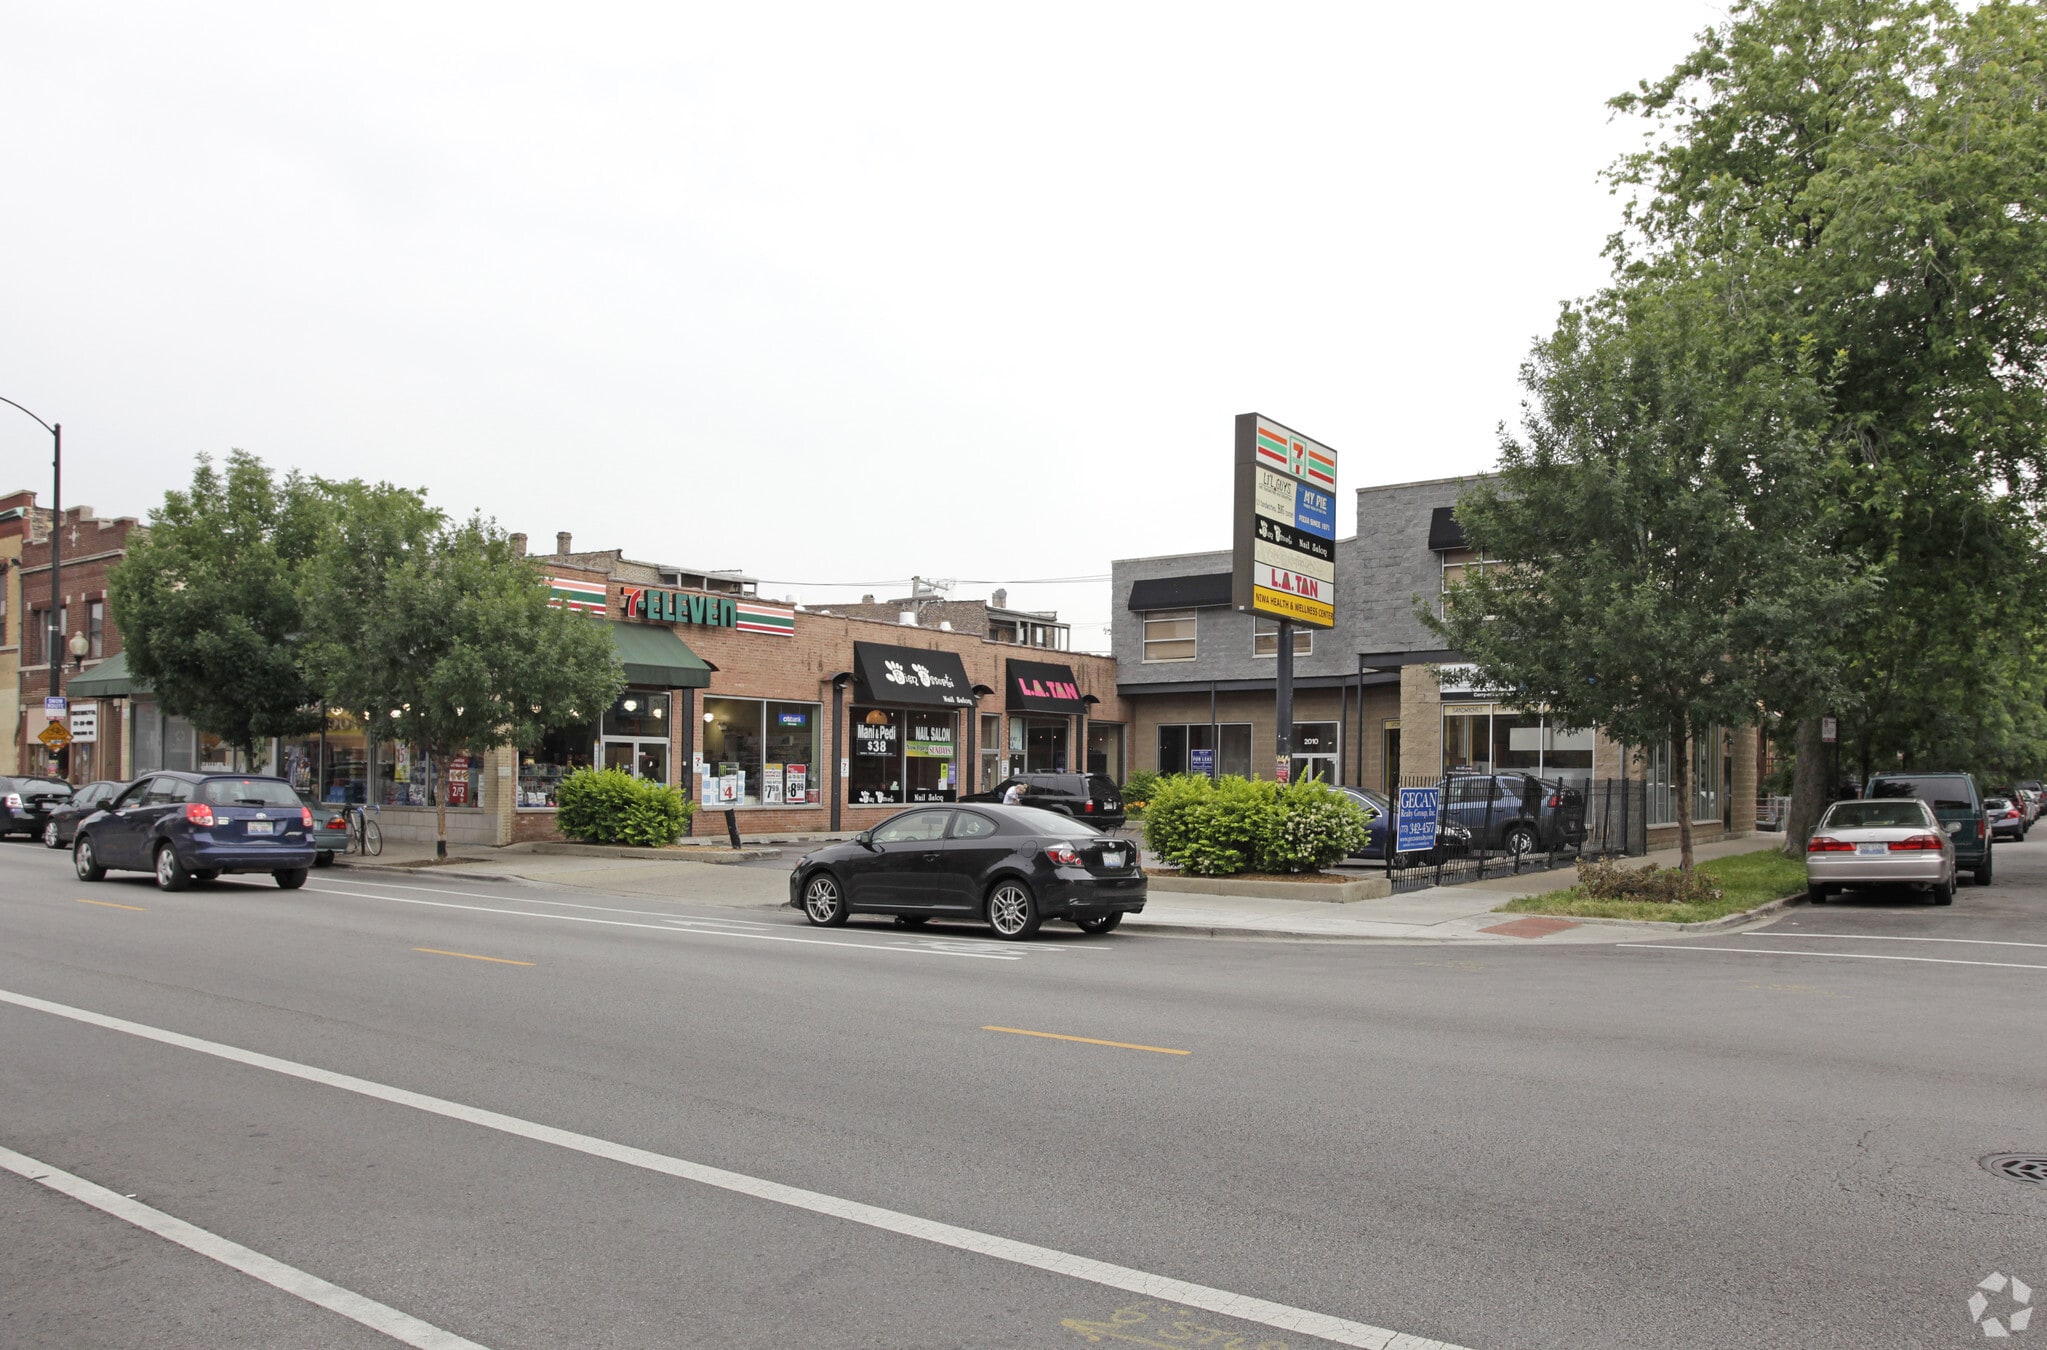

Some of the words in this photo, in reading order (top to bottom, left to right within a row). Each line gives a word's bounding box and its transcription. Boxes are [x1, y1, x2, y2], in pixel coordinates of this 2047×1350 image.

[1304, 490, 1315, 505] MY
[1316, 495, 1327, 510] PIE
[1299, 538, 1310, 550] Nail
[1312, 543, 1328, 557] Salon
[1272, 568, 1294, 591] L.A.
[1296, 575, 1318, 598] TAN
[1270, 596, 1289, 608] HEALTH
[1295, 604, 1318, 616] WELLNESS
[1318, 608, 1334, 620] CENTER
[1018, 678, 1050, 697] L.A.
[1046, 680, 1079, 700] TAN
[956, 696, 973, 706] Salon
[858, 724, 874, 739] Mani
[880, 725, 896, 740] Pedi
[916, 726, 928, 740] NAIL
[930, 727, 950, 742] SALON
[867, 741, 886, 752] $38
[928, 794, 944, 802] Salon
[1401, 792, 1438, 808] GECAN
[1401, 809, 1413, 819] Realty
[1409, 822, 1434, 834] 342-4577
